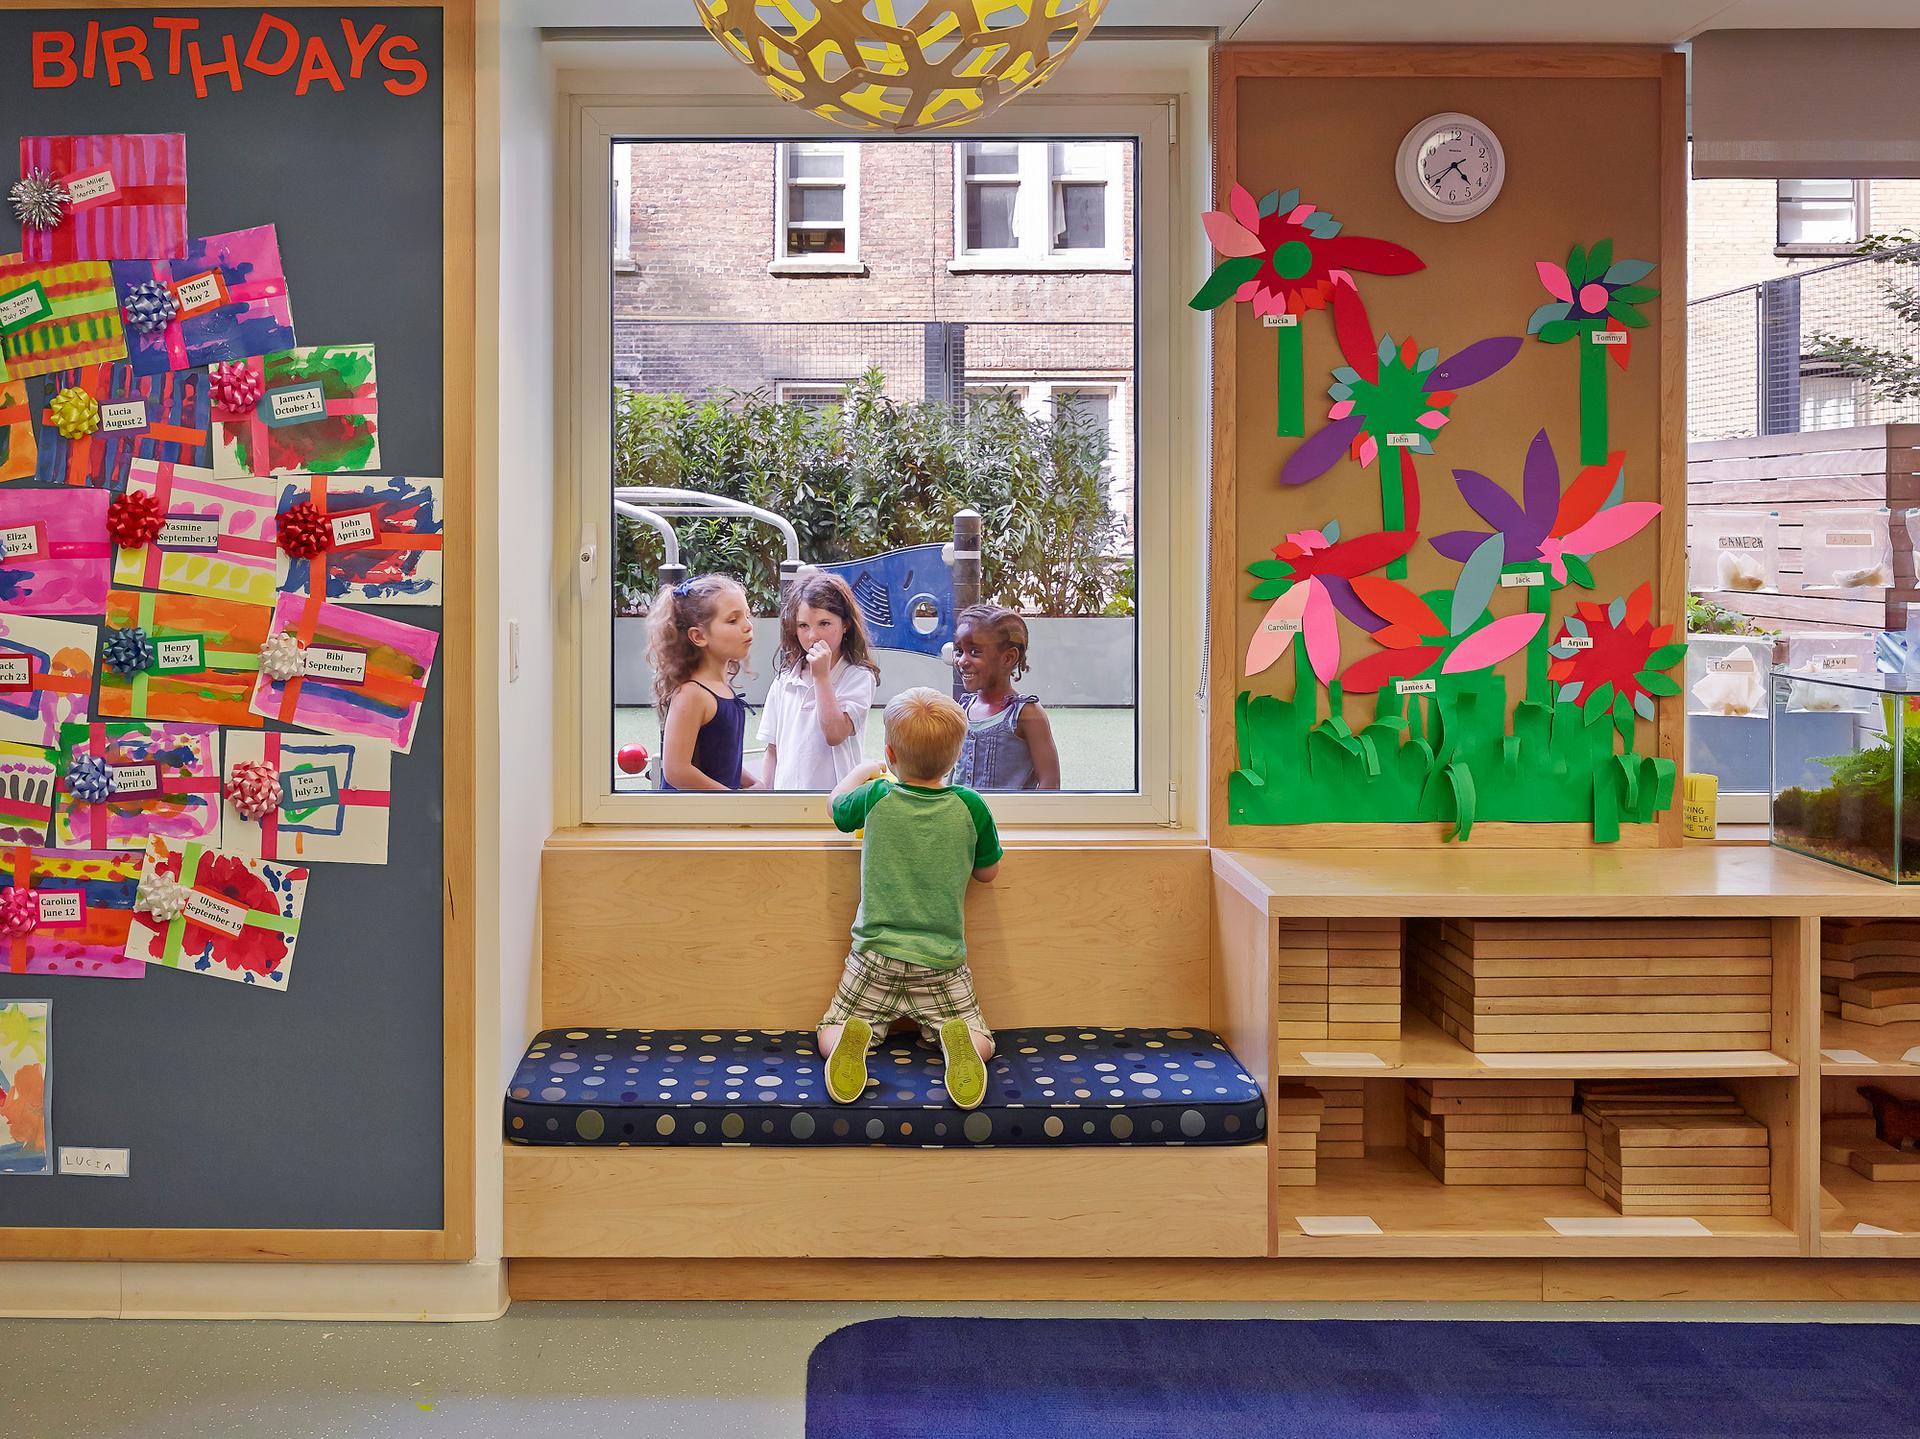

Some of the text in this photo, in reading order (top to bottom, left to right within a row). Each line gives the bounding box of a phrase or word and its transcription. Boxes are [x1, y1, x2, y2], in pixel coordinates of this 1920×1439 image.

[32, 13, 428, 98] BIRTHDAYS
[1450, 130, 1462, 141] 12
[1478, 148, 1486, 158] 2
[1482, 162, 1489, 173] 3
[86, 176, 105, 186] Miller
[1476, 177, 1482, 187] 4
[76, 188, 97, 199] March
[1435, 185, 1442, 196] 7
[1449, 190, 1456, 201] 6
[1464, 187, 1472, 198] 5
[180, 280, 210, 295] N'Mour
[185, 290, 210, 305] May 2
[3, 313, 17, 322] July
[1268, 317, 1289, 325] Lucia
[1596, 334, 1623, 343] Tommy
[279, 391, 315, 406] James A.
[108, 408, 132, 417] Lucia
[275, 401, 321, 416] October 11
[105, 417, 143, 429] August 2
[1392, 436, 1409, 444] John
[165, 522, 202, 532] Yasmine
[340, 519, 361, 530] John
[6, 532, 27, 541] Eliza
[158, 533, 218, 544] September 19
[336, 527, 371, 541] April 30
[6, 542, 33, 553] uly 24
[1515, 576, 1531, 585] Jack
[1267, 623, 1298, 631] Caroline
[164, 644, 191, 653] Henry
[1567, 640, 1589, 648] Arjun
[162, 654, 194, 665] May 24
[326, 652, 344, 661] Bibi
[0, 662, 15, 670] ack
[308, 660, 363, 674] September 7
[1713, 661, 1733, 670] TEA
[0, 672, 27, 681] rch 23
[1401, 684, 1424, 692] James
[118, 769, 146, 778] Amiah
[116, 778, 152, 790] April 10
[297, 776, 314, 785] Tea
[294, 785, 324, 798] July 21
[40, 897, 77, 906] Caroline
[200, 896, 230, 915] Ulysses
[43, 908, 76, 918] June 12
[185, 902, 242, 931] September 19
[65, 1155, 112, 1171] LUCIA
